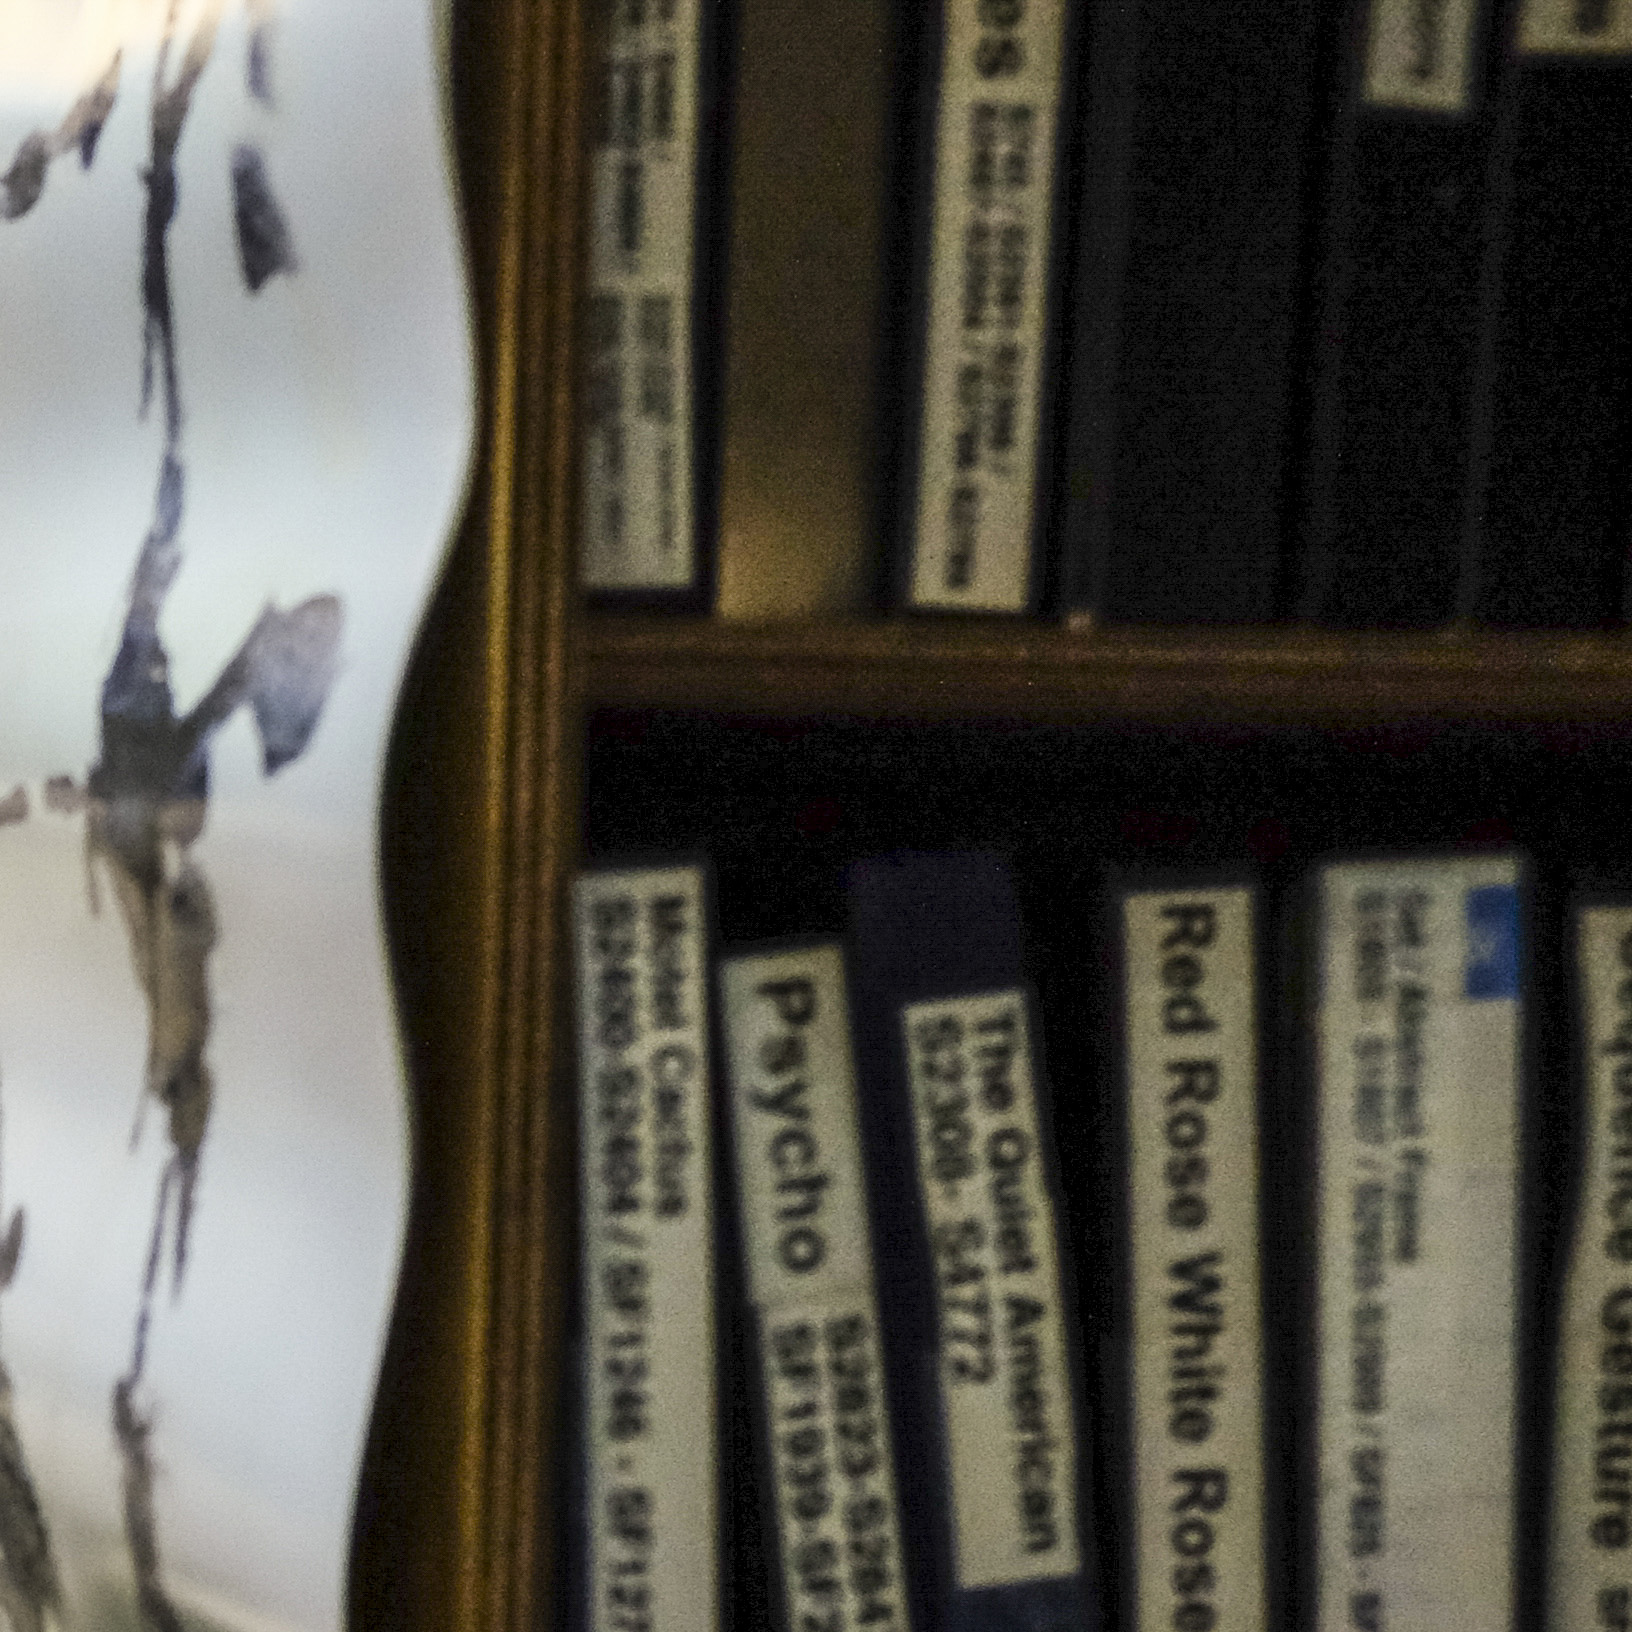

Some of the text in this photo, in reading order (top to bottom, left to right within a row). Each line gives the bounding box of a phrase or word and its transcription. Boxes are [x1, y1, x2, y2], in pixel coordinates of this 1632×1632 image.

[1160, 903, 1221, 1034] Red
[652, 1047, 695, 1217] Cactus
[751, 974, 832, 1274] Psycho
[1165, 1059, 1225, 1230] Rose
[975, 1012, 1058, 1553] The Quiet American
[1167, 1251, 1228, 1444] White
